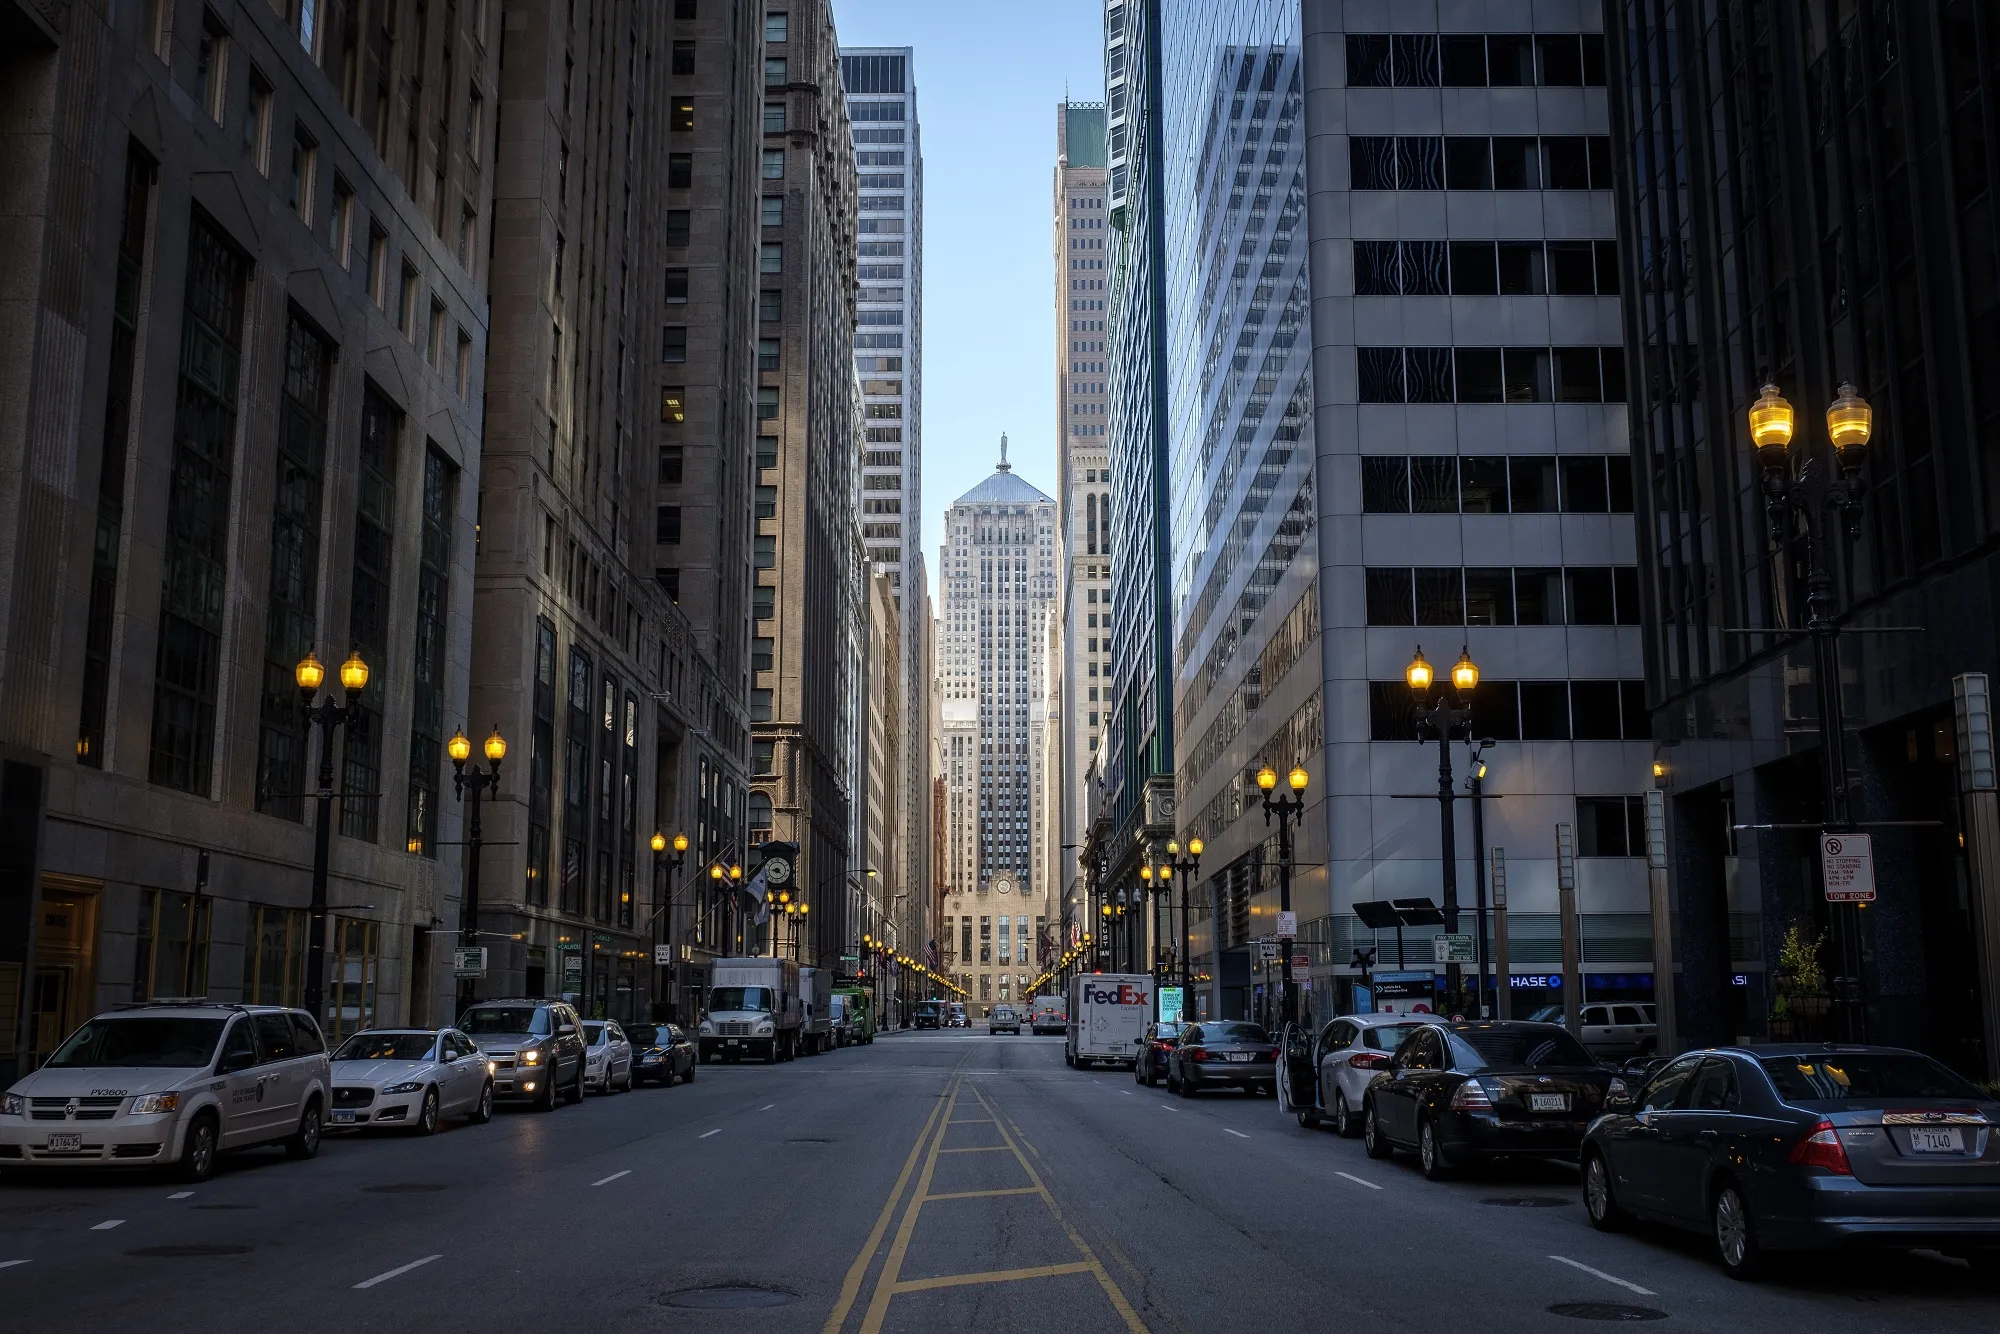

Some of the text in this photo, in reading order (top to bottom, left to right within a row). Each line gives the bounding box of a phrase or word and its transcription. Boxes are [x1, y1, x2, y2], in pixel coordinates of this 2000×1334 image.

[1510, 976, 1547, 987] HASE
[1084, 984, 1149, 1005] FedEx
[1925, 1134, 1951, 1148] 7140
